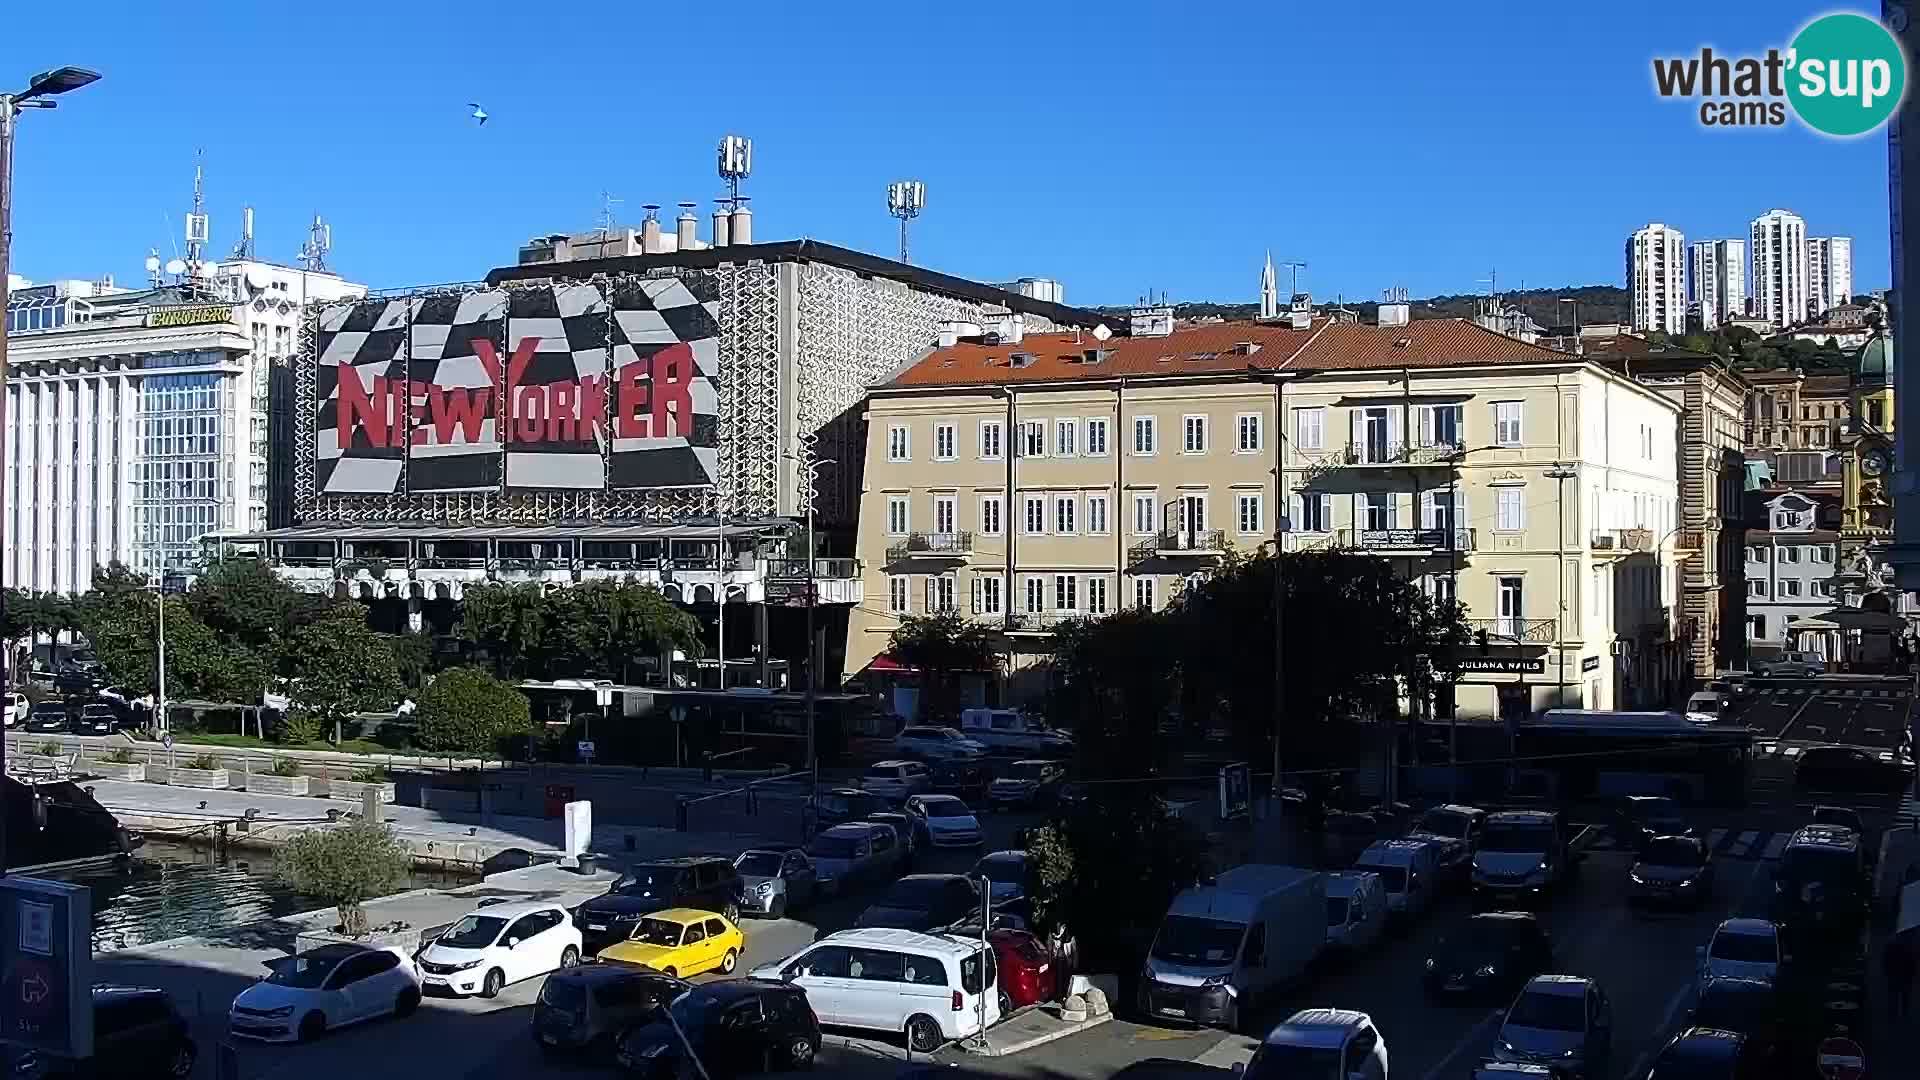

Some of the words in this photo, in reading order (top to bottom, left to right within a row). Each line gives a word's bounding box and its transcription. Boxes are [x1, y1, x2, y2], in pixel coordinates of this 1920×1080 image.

[337, 360, 494, 449] NEW
[471, 336, 693, 443] YORKER
[1458, 661, 1505, 670] JULIANA
[1508, 662, 1541, 670] NAILS
